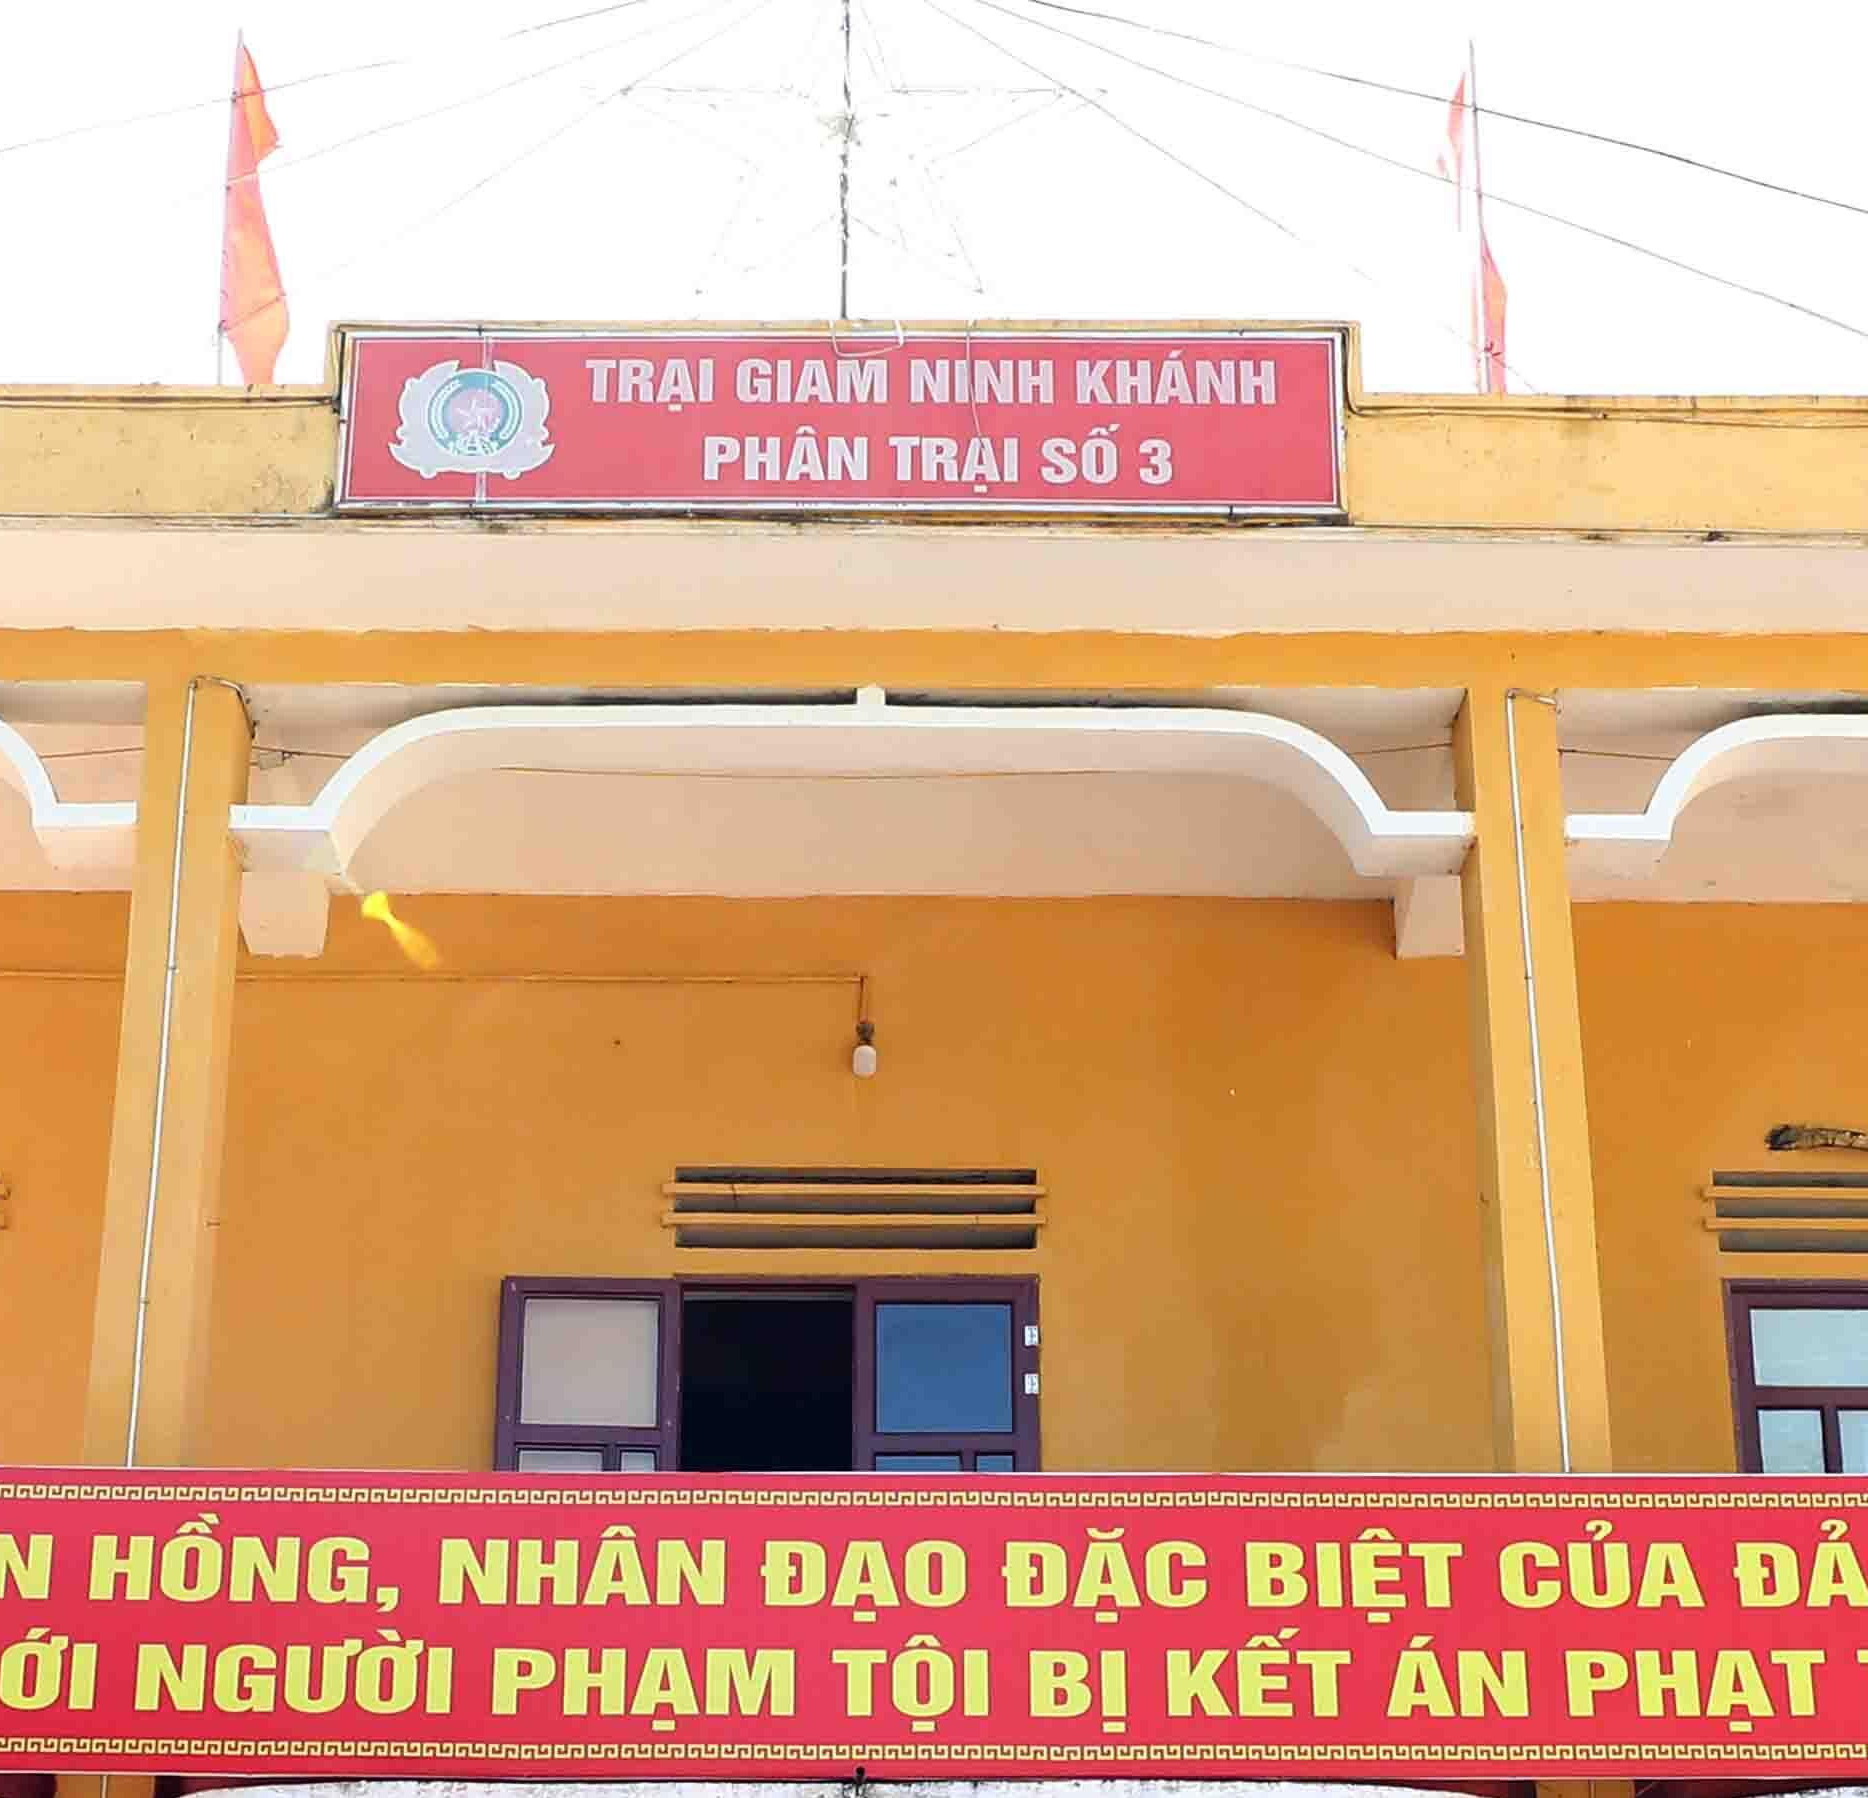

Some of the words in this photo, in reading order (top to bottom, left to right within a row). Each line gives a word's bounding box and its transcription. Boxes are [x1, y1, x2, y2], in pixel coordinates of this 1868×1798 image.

[586, 359, 714, 411] TRẠI
[737, 359, 888, 403] GIAM
[911, 359, 1054, 403] NINH
[1077, 350, 1276, 404] KHÁNH
[704, 426, 868, 481] PHÂN
[889, 436, 1018, 492] TRẠI
[1042, 424, 1117, 484] SỐ
[1140, 440, 1173, 484] 3
[89, 1514, 399, 1611] HỒNG,
[439, 1526, 726, 1606] NHÂN
[761, 1541, 967, 1622] ĐẠO
[1002, 1528, 1207, 1622] ĐẶC
[1246, 1528, 1463, 1622] BIỆT
[1500, 1520, 1705, 1608] CỦA
[135, 1630, 453, 1714] NGƯỜI
[492, 1648, 795, 1731] PHẠM
[832, 1635, 989, 1732] TỘI
[1030, 1650, 1127, 1732] BỊ
[1167, 1628, 1351, 1717] KẾT
[1388, 1636, 1529, 1717] ÁN
[1566, 1650, 1826, 1731] PHẠT
